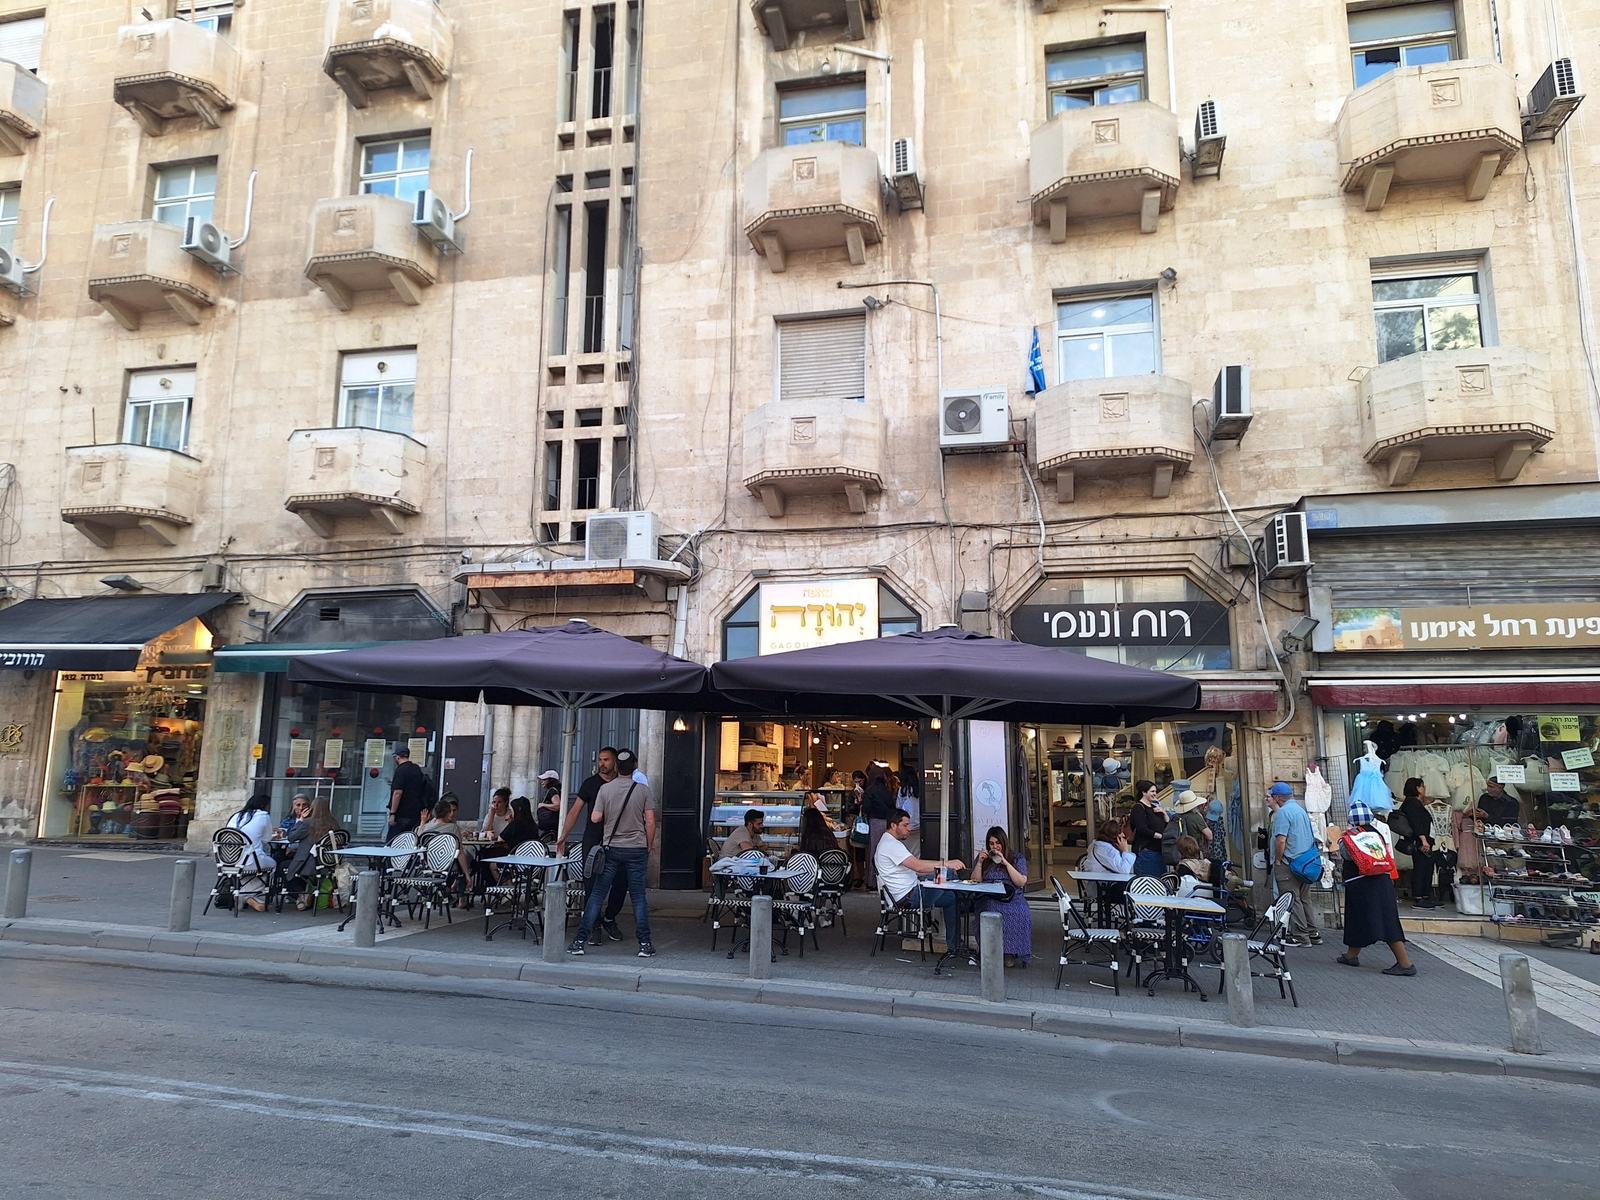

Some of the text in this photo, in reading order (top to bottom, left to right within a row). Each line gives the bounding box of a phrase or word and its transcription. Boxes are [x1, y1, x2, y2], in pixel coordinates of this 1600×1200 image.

[1043, 609, 1192, 639] רות ונעמי
[1410, 613, 1600, 641] פינת רחל אימנו
